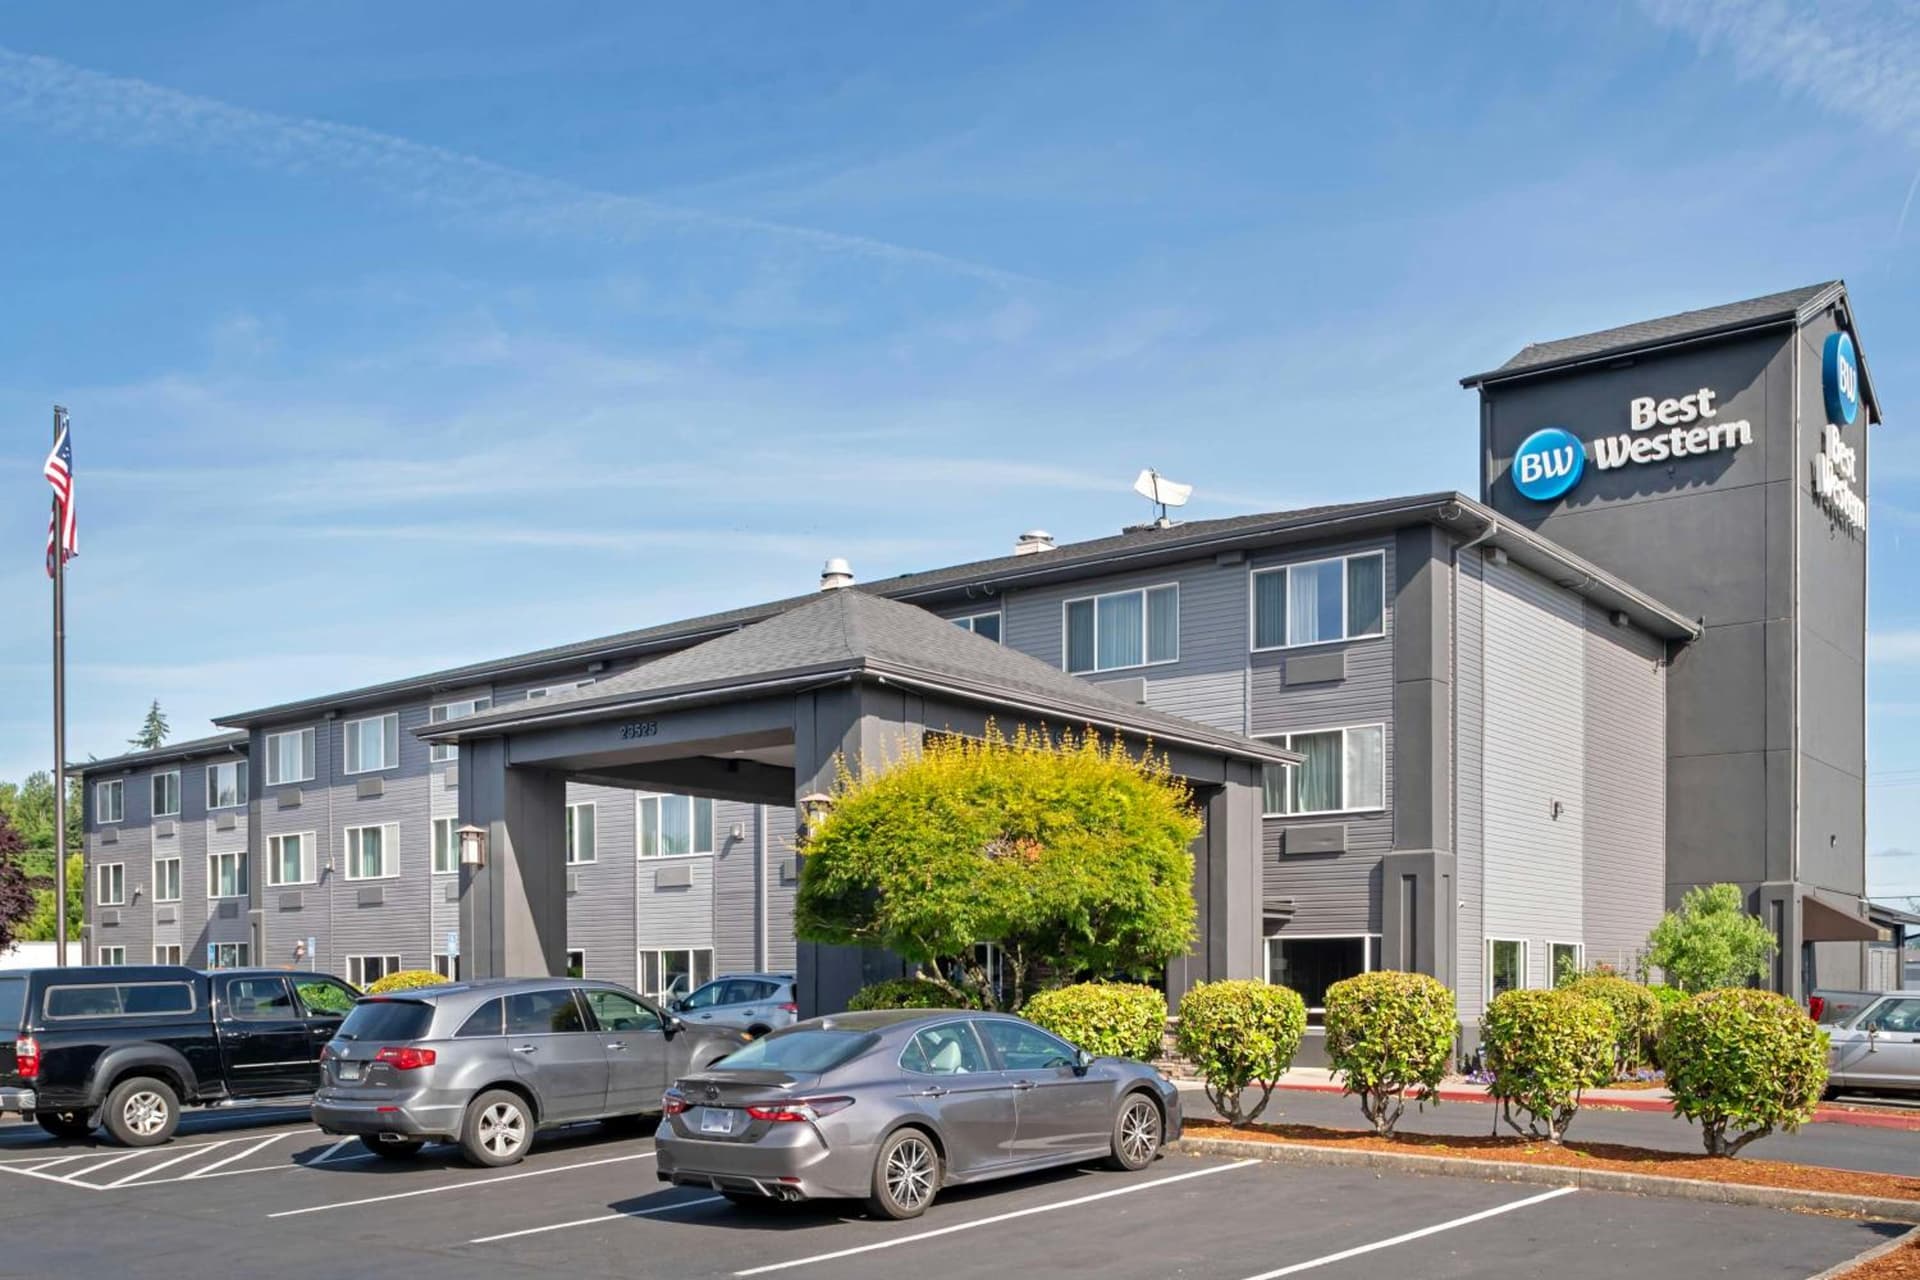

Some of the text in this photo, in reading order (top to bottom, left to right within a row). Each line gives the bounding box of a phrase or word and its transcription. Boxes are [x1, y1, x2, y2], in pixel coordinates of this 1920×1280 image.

[1838, 356, 1858, 403] BW
[1630, 387, 1717, 431] Best
[1521, 445, 1574, 483] BW
[1594, 419, 1753, 470] Western
[1826, 424, 1857, 484] Best
